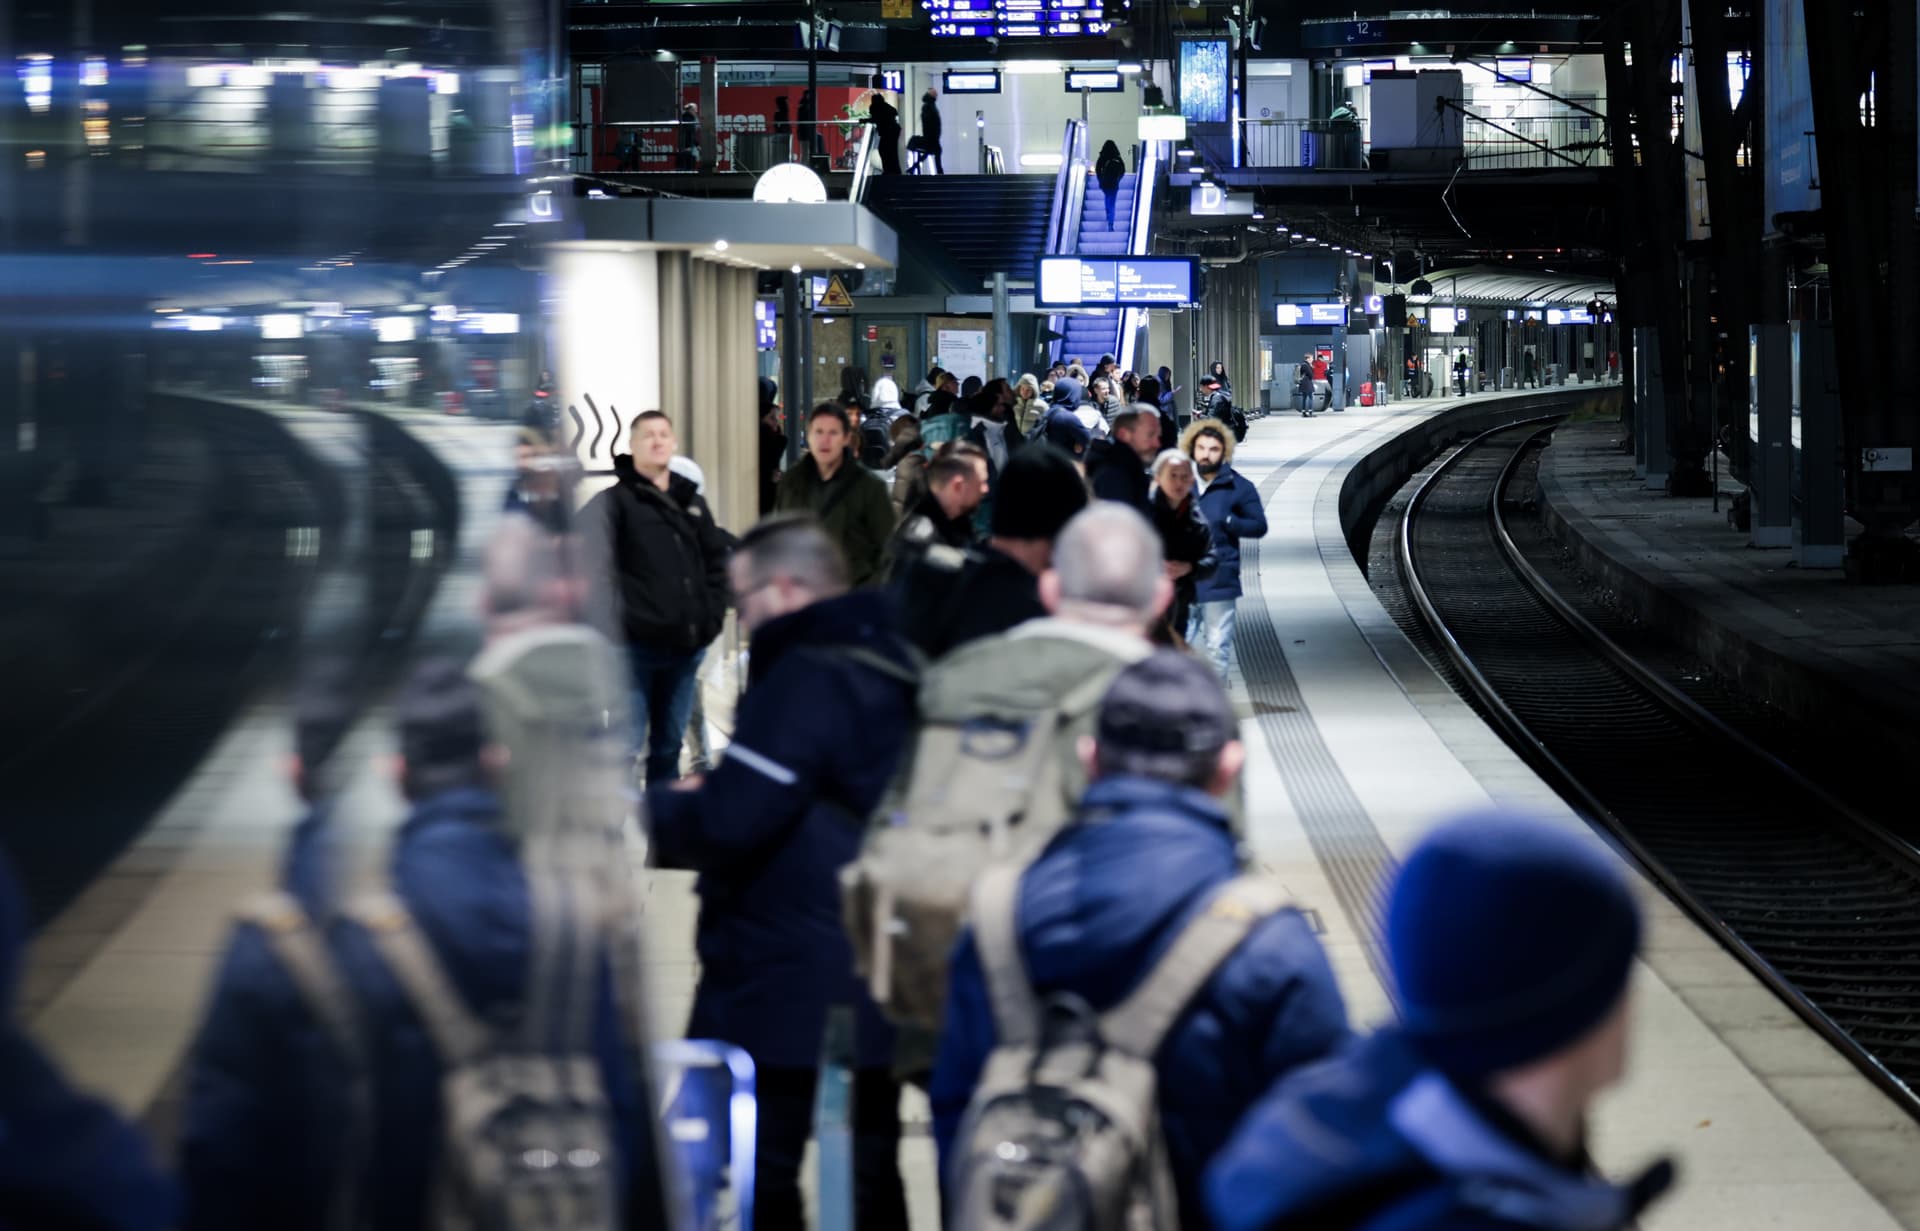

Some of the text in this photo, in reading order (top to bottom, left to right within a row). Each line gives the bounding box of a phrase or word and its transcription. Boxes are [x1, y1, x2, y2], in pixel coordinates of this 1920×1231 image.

[1356, 22, 1369, 34] 12
[884, 71, 901, 89] 11
[1201, 186, 1221, 209] D
[1369, 296, 1382, 311] C
[1457, 309, 1467, 320] B
[1603, 312, 1613, 323] A
